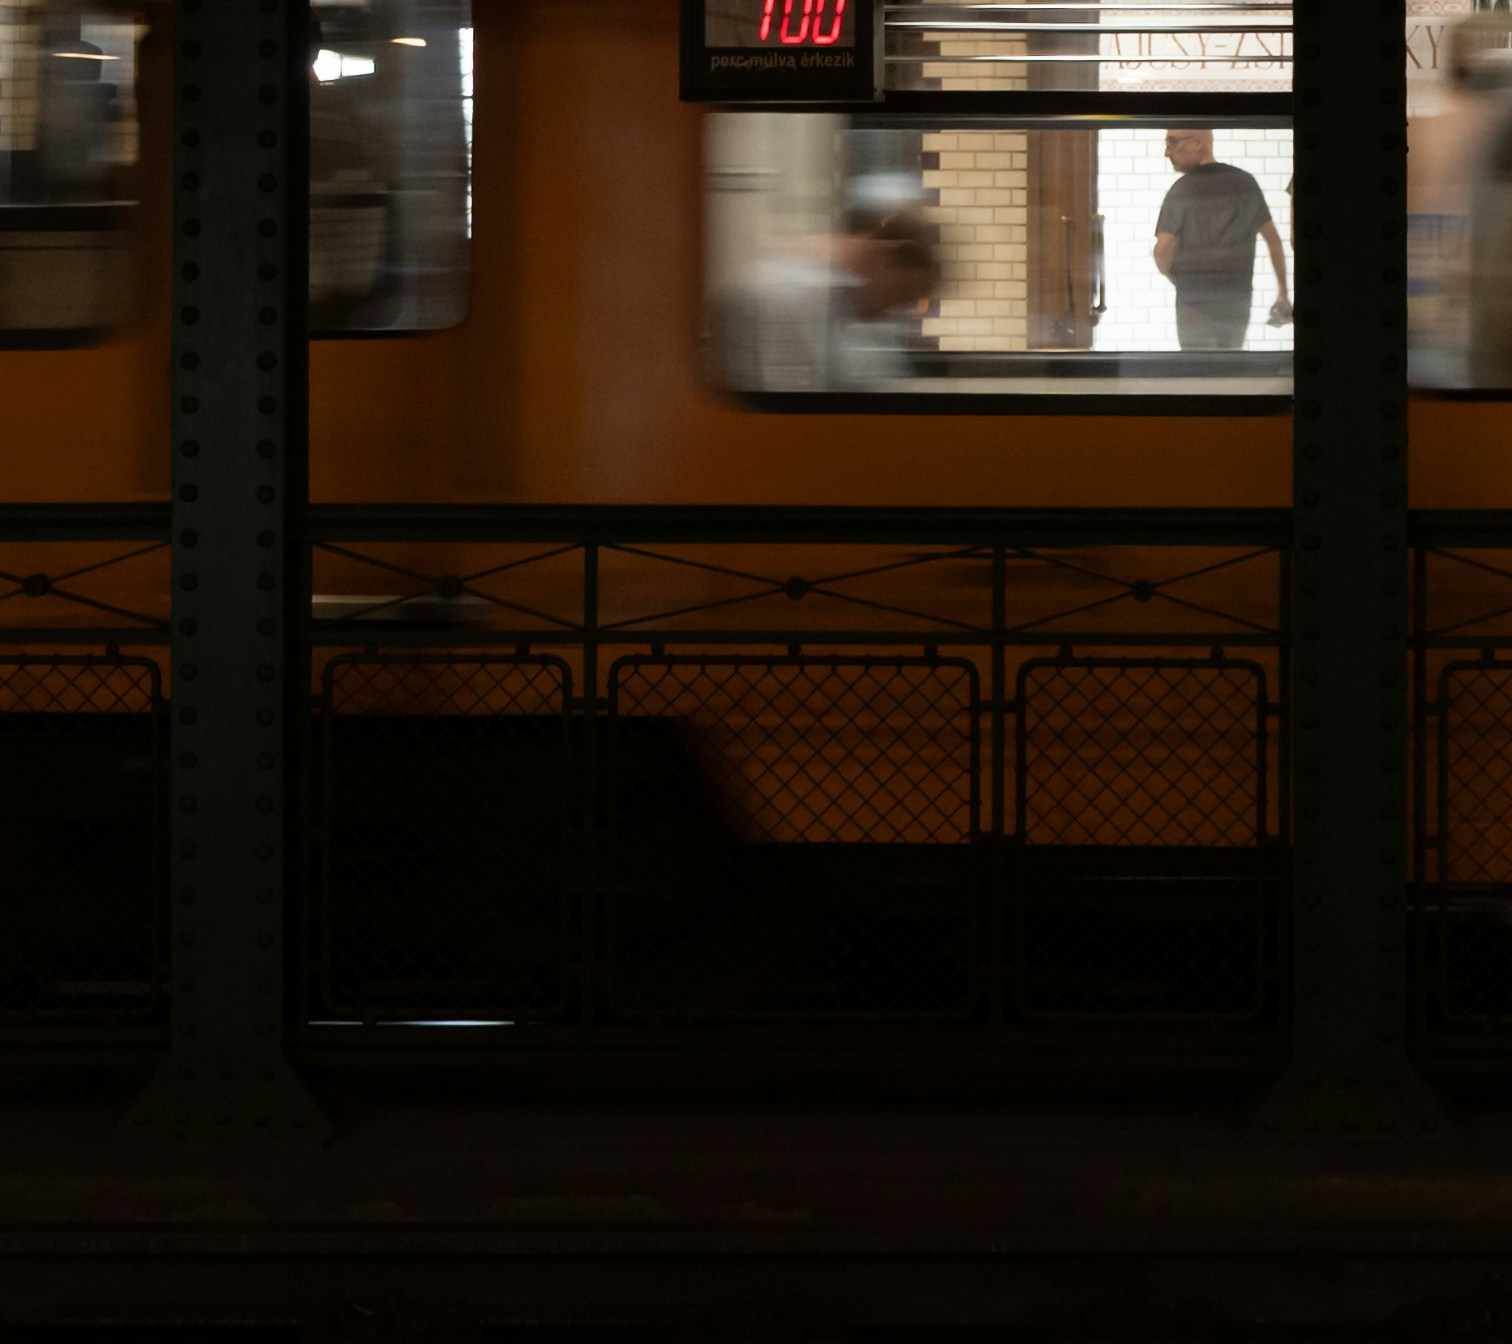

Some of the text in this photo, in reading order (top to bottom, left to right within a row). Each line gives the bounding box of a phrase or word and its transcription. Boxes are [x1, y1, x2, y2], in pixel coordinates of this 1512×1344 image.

[711, 51, 855, 71] perc múlva érkezik
